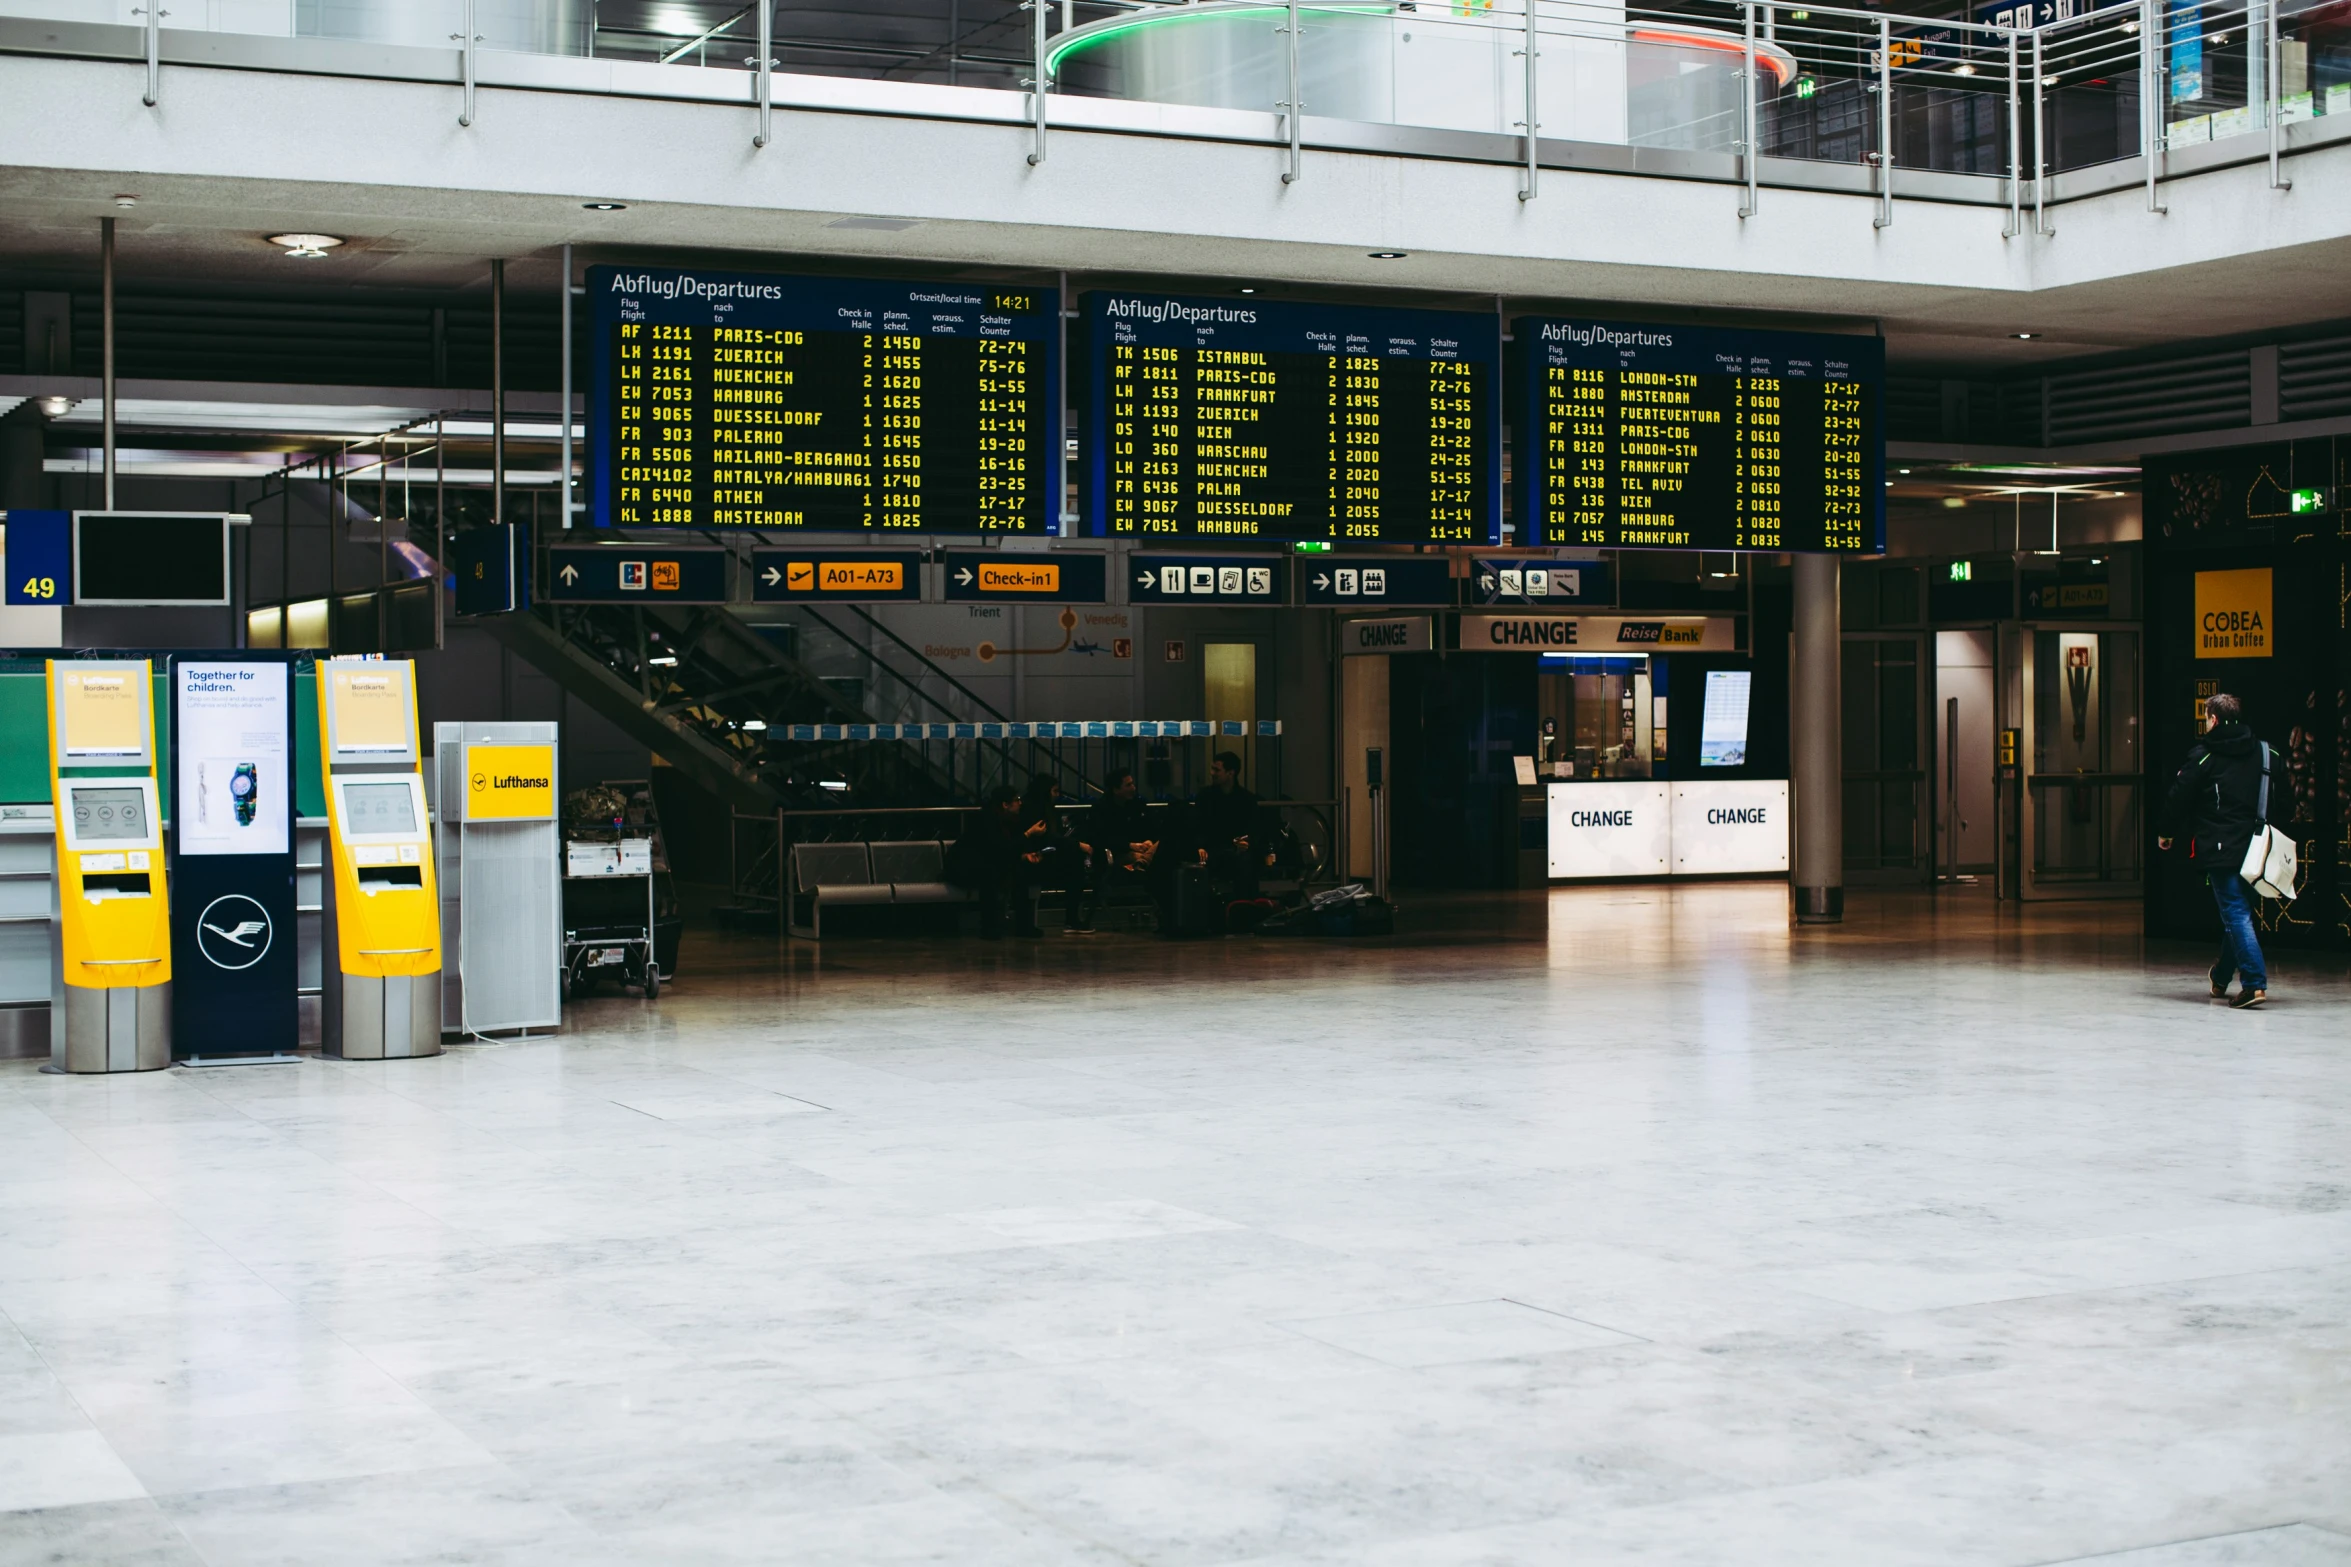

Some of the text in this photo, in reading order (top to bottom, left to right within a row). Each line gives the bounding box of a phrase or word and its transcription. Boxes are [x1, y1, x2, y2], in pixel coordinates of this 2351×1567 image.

[611, 273, 781, 301] Abflug/Departures
[620, 298, 1011, 325] Flug nach Check in planm. vorauss. Schalter
[909, 292, 1030, 310] Ortszeit/local time 14:21
[1106, 299, 1257, 325] Abflug/Departures
[620, 309, 1011, 336] Flight to Halle sched. estim. Counter
[621, 324, 1026, 355] AF 1211 PARIS-CDG 2 1450 72-74
[1115, 322, 1131, 332] Flug
[1196, 327, 1214, 335] nach
[1306, 332, 1328, 341] Check
[1329, 333, 1336, 341] in
[1346, 334, 1370, 344] planm.
[1430, 338, 1459, 348] Schalter
[1115, 333, 1458, 358] Flight to Halle sched. estim. Counter
[1541, 324, 1673, 348] Abflug/Departures
[621, 344, 1026, 374] LX 1191 ZUERICH 2 1455 75-76
[1115, 345, 1471, 376] TK 1506 ISTANBUL 2 1825 77-81
[1548, 345, 1563, 355] Flug
[1548, 355, 1568, 365] Flight
[621, 364, 1026, 394] LH 2161 MUENCHEN 2 1620 51-55
[1115, 365, 1471, 394] AF 1811 PARIS-CDG 2 1830 72-76
[1549, 367, 1860, 395] FR 8116 LONDON-STN 1 2235 17-17
[621, 385, 1026, 413] EW 7053 HAMBURG 1 1625 11-14
[1549, 385, 1860, 412] KL 1880 AMSTERDAM 2 0600 72-77
[621, 405, 1026, 433] EW 9065 DUESSELDORF 1 1630 11-14
[1115, 441, 1471, 467] LO 360 WARSCHAU 1 2000 24-25
[1115, 479, 1471, 503] FR 6436 PALMA 1 2040 17-17
[1549, 493, 1861, 514] OS 136 WIEN 2 0810 72-73
[22, 577, 56, 599] 49
[826, 568, 895, 585] A01-A73
[983, 569, 1053, 587] Check-in1
[968, 606, 1001, 618] Trient
[1084, 613, 1128, 629] Venedig
[1359, 622, 1407, 647] CHANGE
[1490, 621, 1578, 645] CHANGE
[1621, 625, 1699, 644] Reise Bank
[2203, 632, 2264, 648] Urban Coffee
[924, 644, 971, 660] Bologna
[187, 670, 255, 682] Together for
[187, 682, 236, 693] children.
[2197, 682, 2217, 696] OSLO
[493, 775, 549, 789] Lufthansa
[1571, 810, 1633, 827] CHANGE
[1706, 808, 1766, 825] CHANGE
